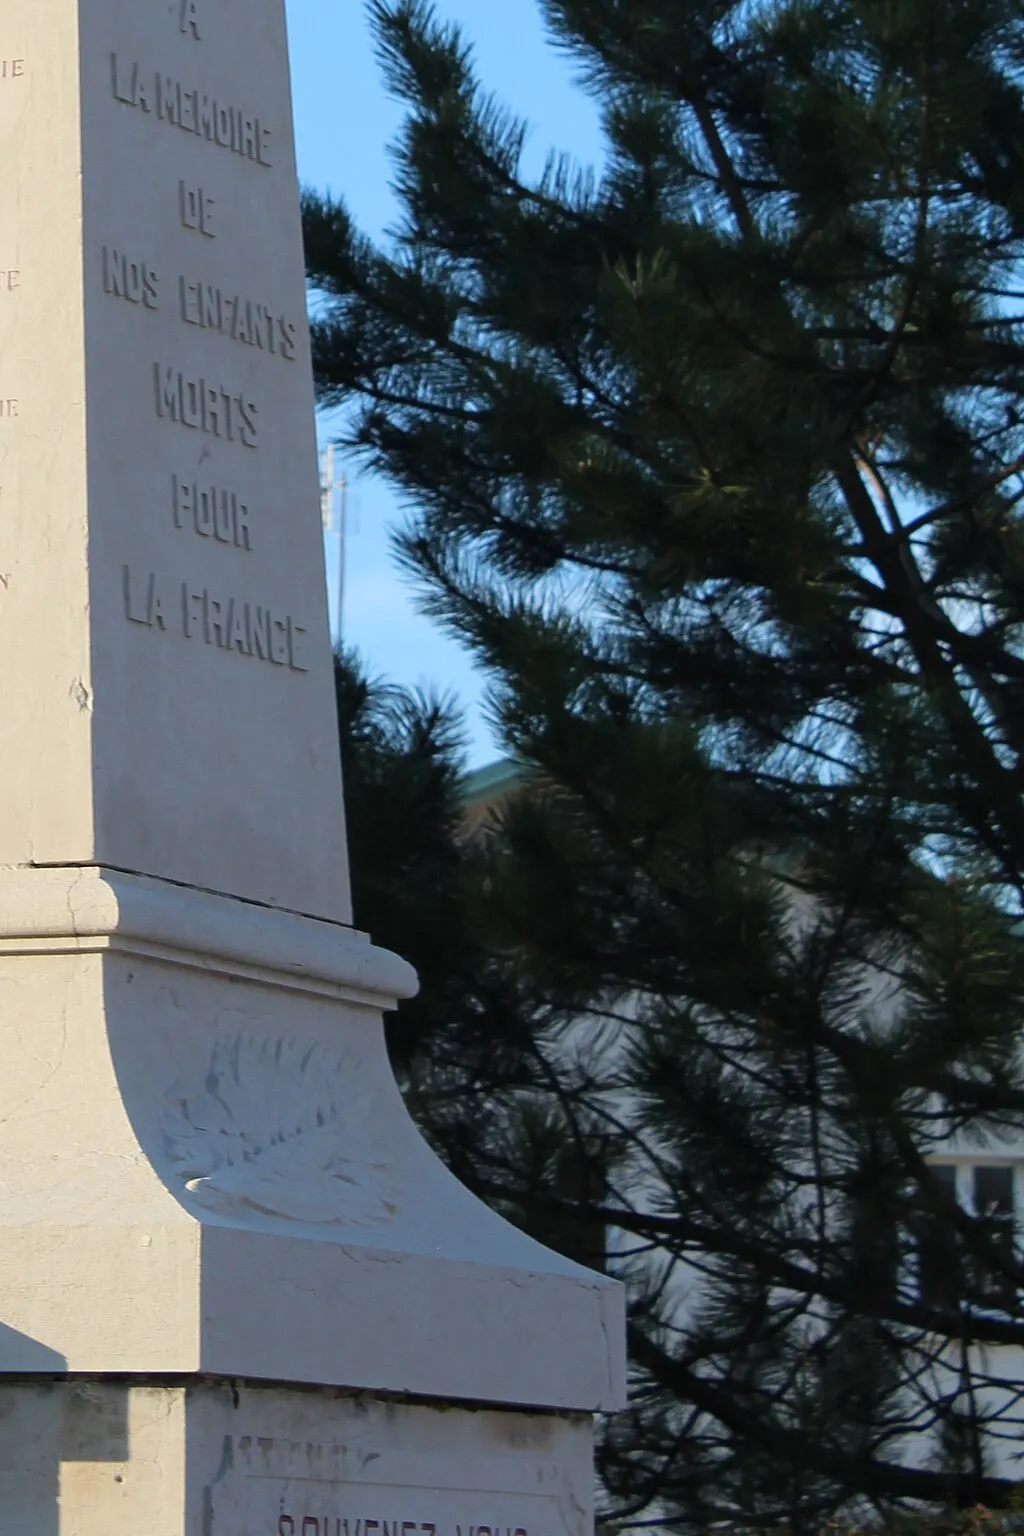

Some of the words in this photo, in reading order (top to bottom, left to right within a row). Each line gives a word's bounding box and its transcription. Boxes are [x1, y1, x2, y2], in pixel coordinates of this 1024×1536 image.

[110, 51, 151, 114] LA
[155, 71, 273, 168] MEMOIRE
[179, 179, 216, 238] DE
[102, 245, 159, 310] NOS
[178, 275, 297, 361] ENFANTS
[153, 362, 259, 449] MORTS
[172, 473, 252, 551] POUR
[123, 564, 167, 631] LA
[181, 582, 309, 672] FRANCE
